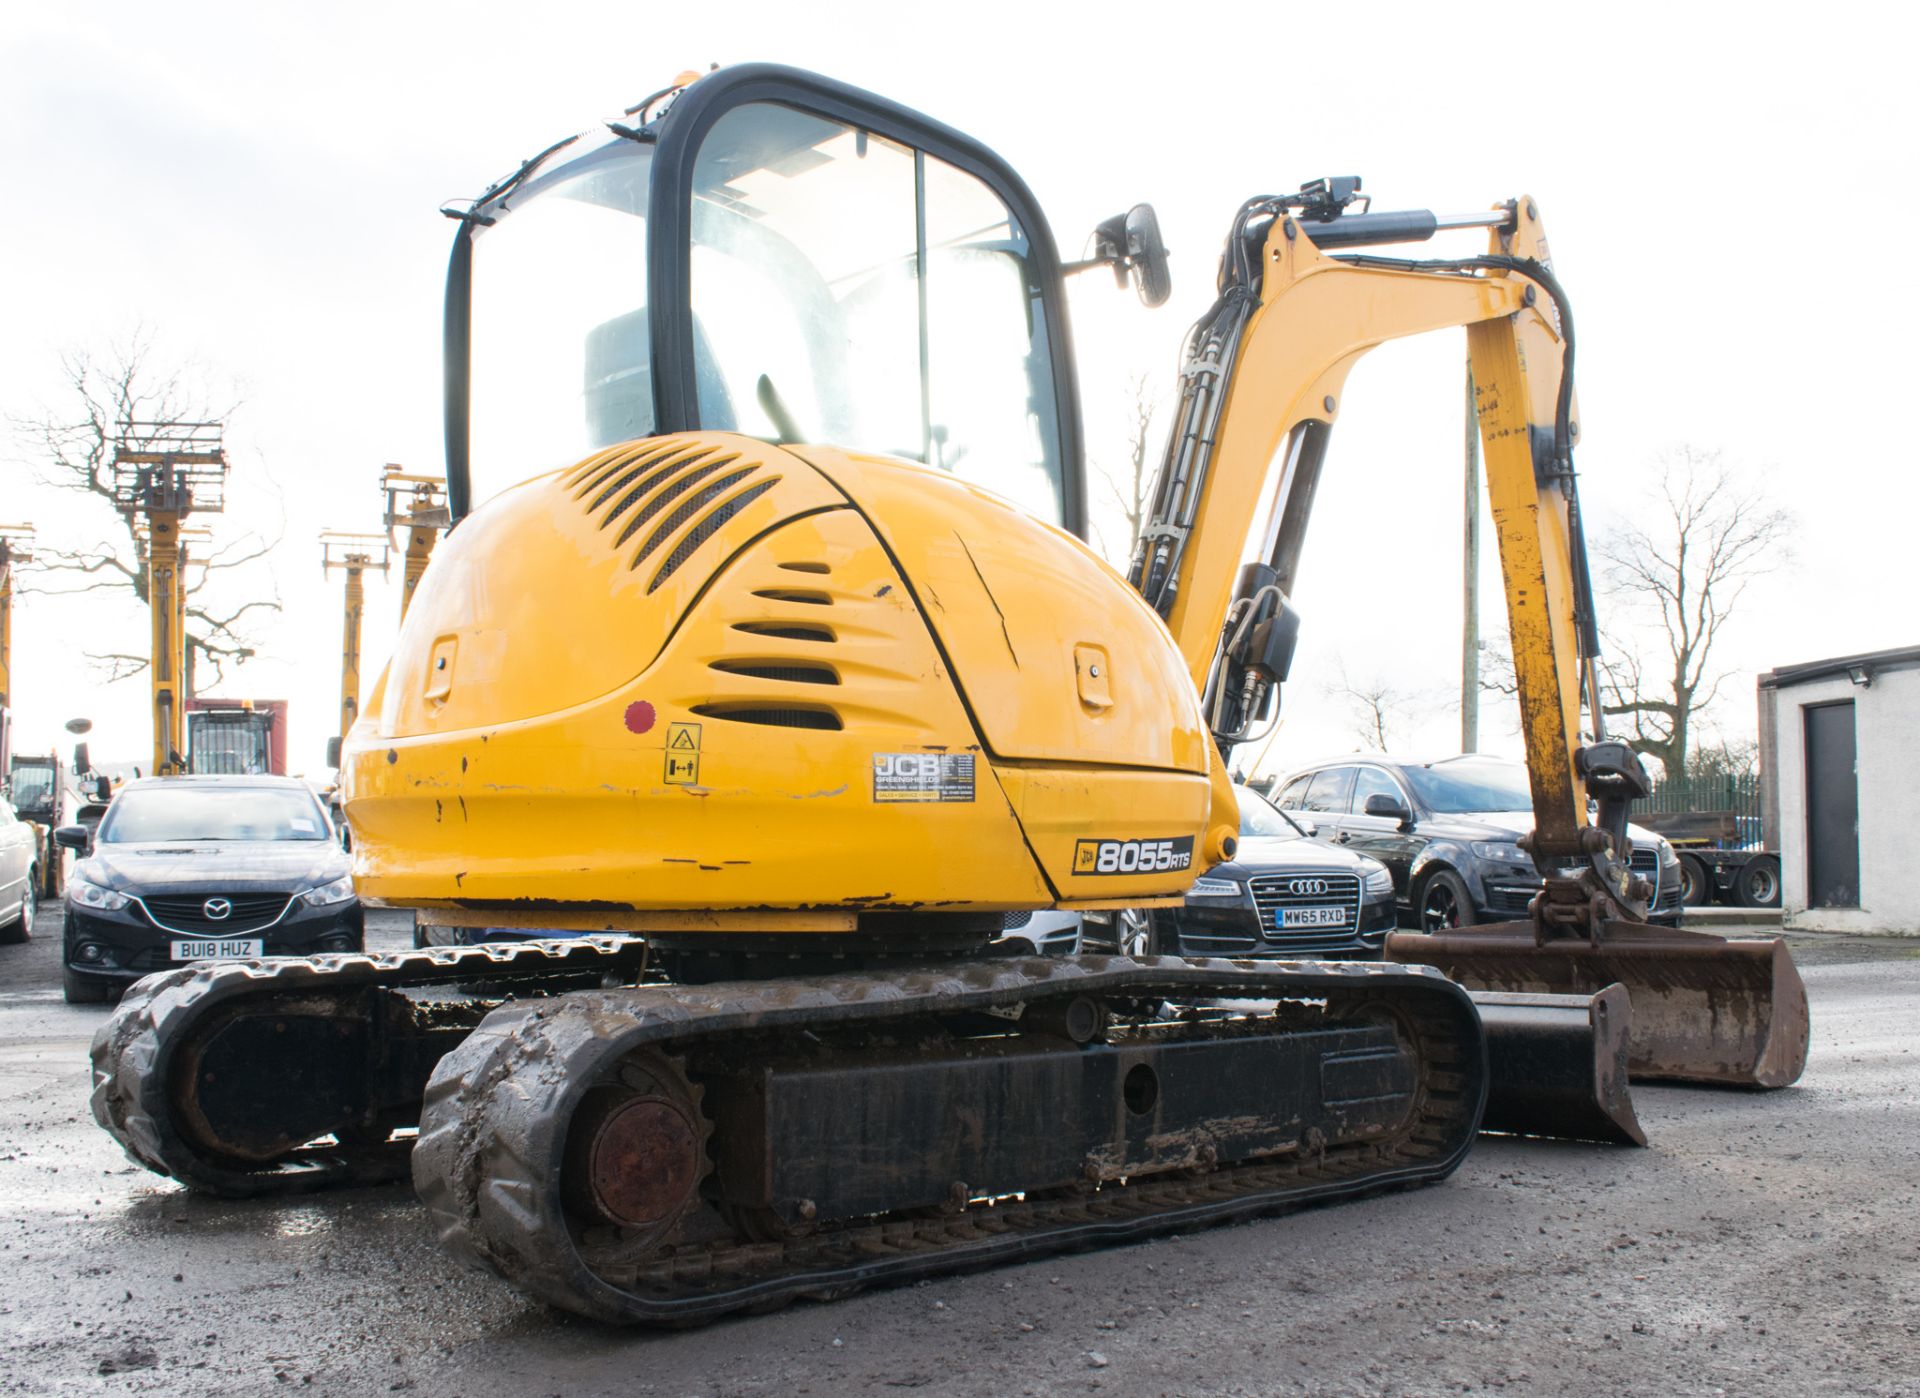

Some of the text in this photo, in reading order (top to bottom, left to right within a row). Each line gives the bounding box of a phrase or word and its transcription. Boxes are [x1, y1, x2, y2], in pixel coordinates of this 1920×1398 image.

[876, 756, 940, 776] JCB
[1284, 909, 1344, 924] MW65 RXD
[181, 941, 251, 957] BU18 HUZ
